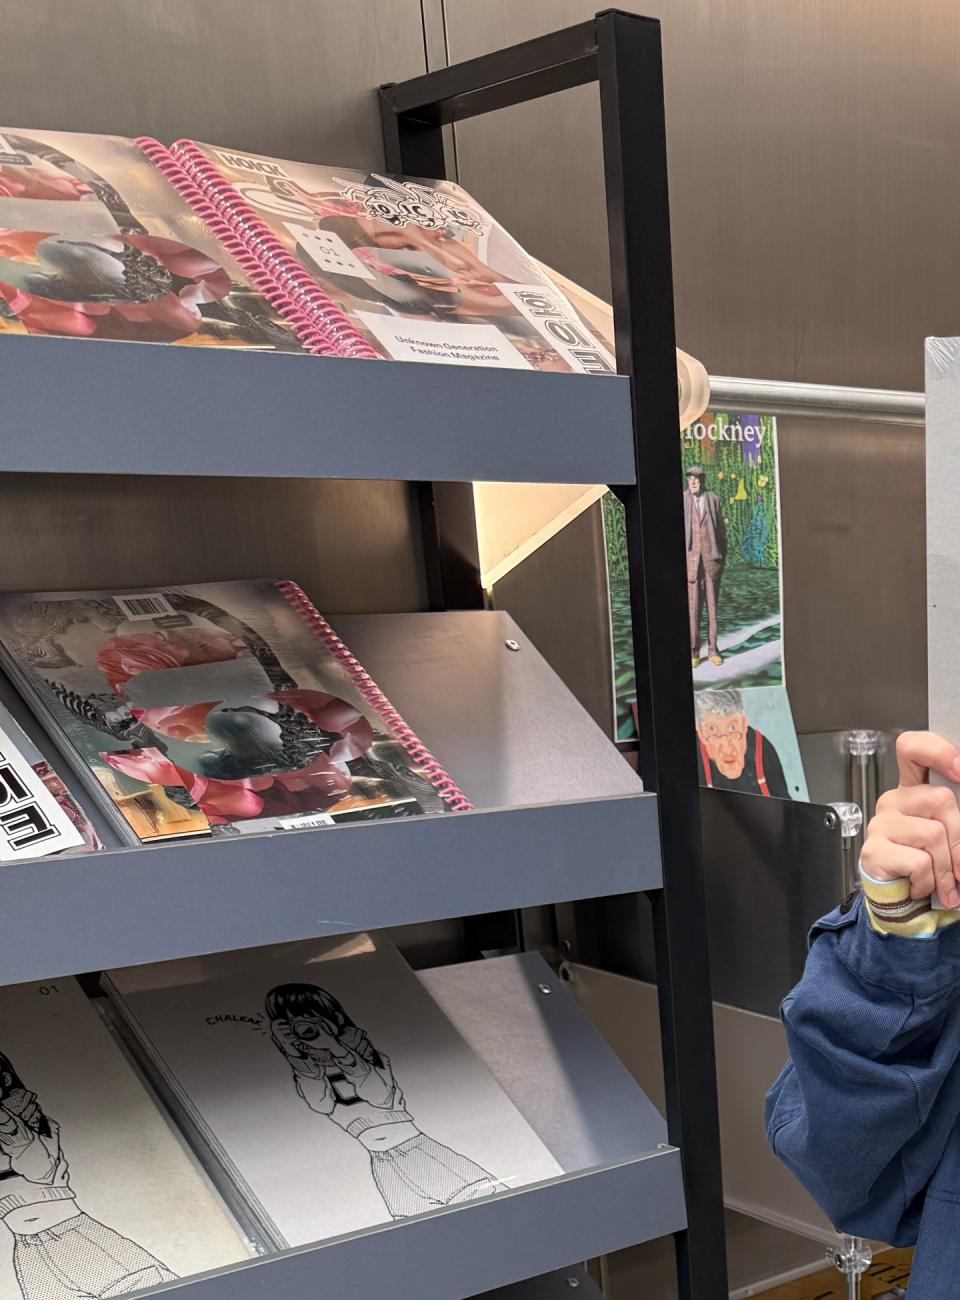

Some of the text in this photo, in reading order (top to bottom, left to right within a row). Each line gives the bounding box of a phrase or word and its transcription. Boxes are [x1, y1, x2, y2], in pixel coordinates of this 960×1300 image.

[219, 153, 284, 176] HOICK
[394, 335, 499, 353] Unknown Generation
[409, 346, 500, 361] Fashion Magazine
